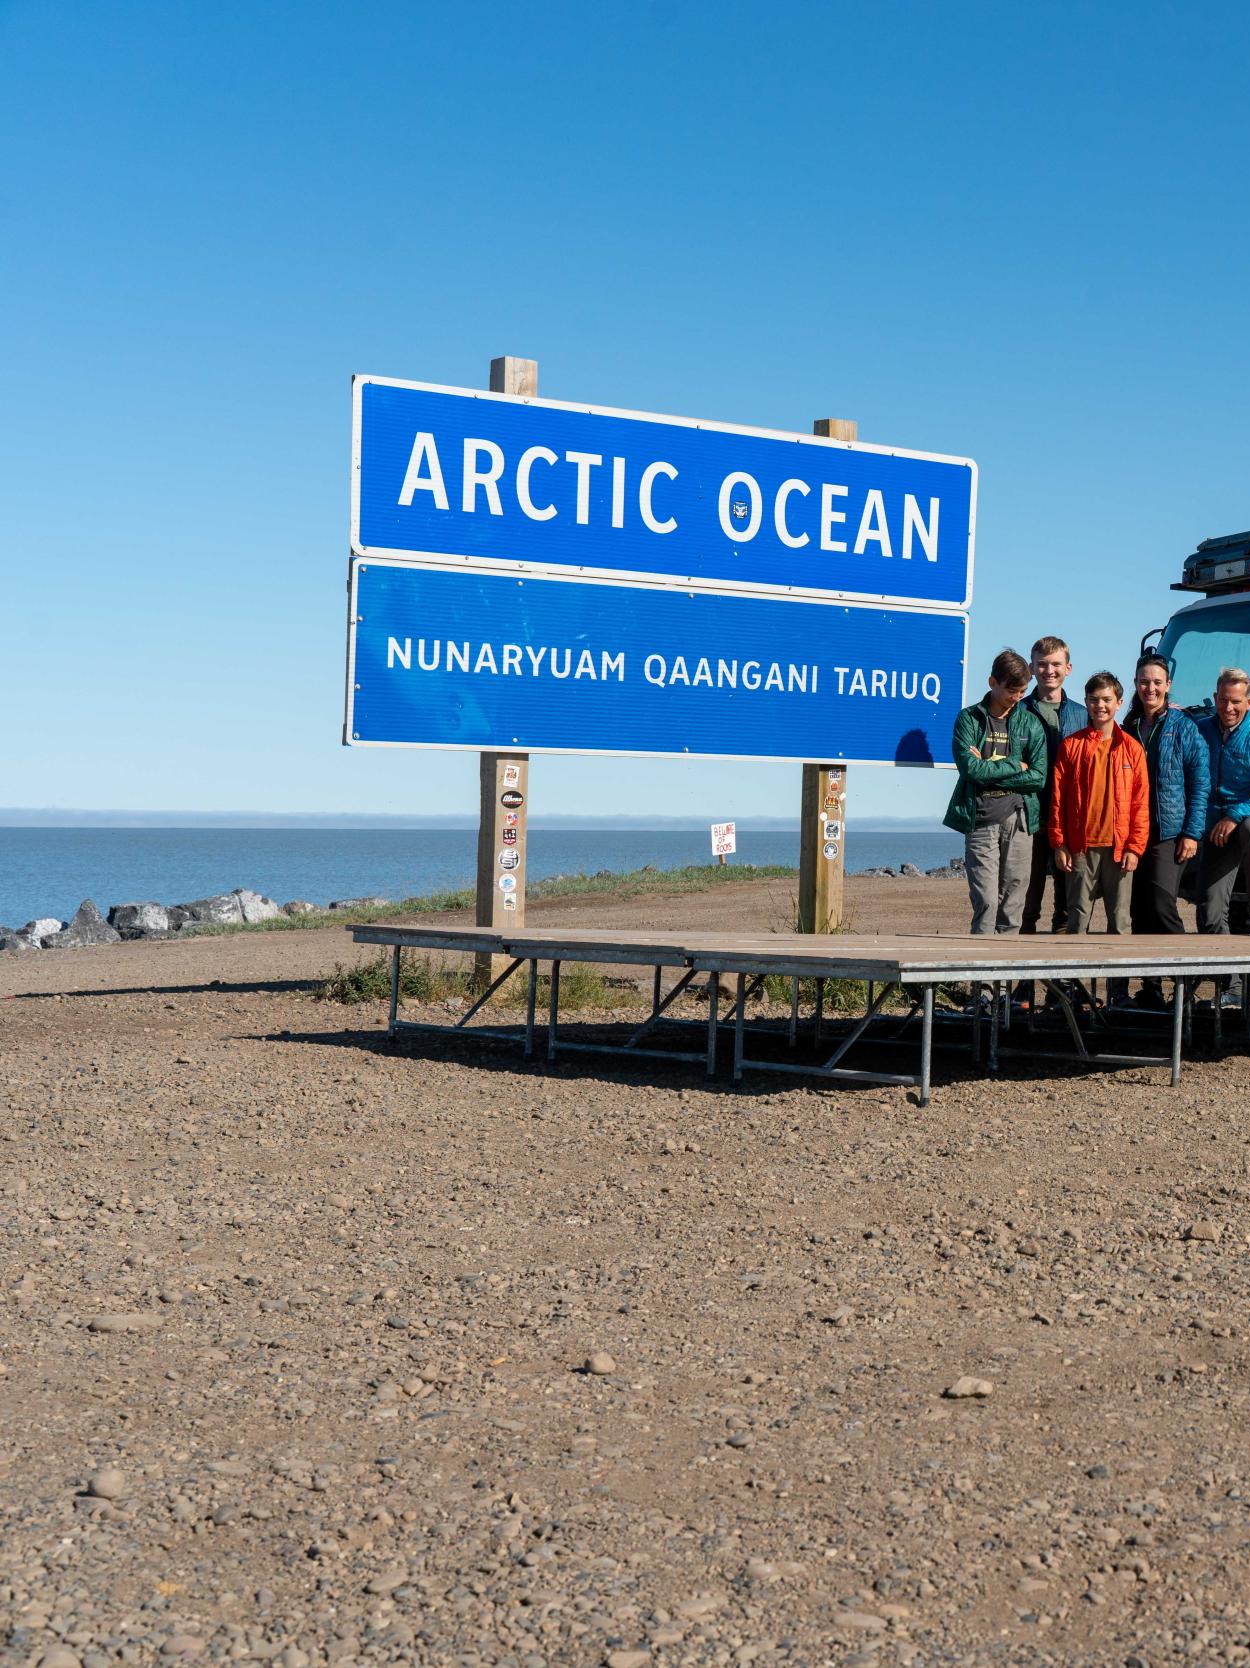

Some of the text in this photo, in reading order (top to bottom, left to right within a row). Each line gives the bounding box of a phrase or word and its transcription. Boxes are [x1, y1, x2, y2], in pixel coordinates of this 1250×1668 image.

[398, 432, 940, 562] ARCTIC OCEAN
[386, 637, 942, 705] NUNARYUAM QAANGANI TARIUQ
